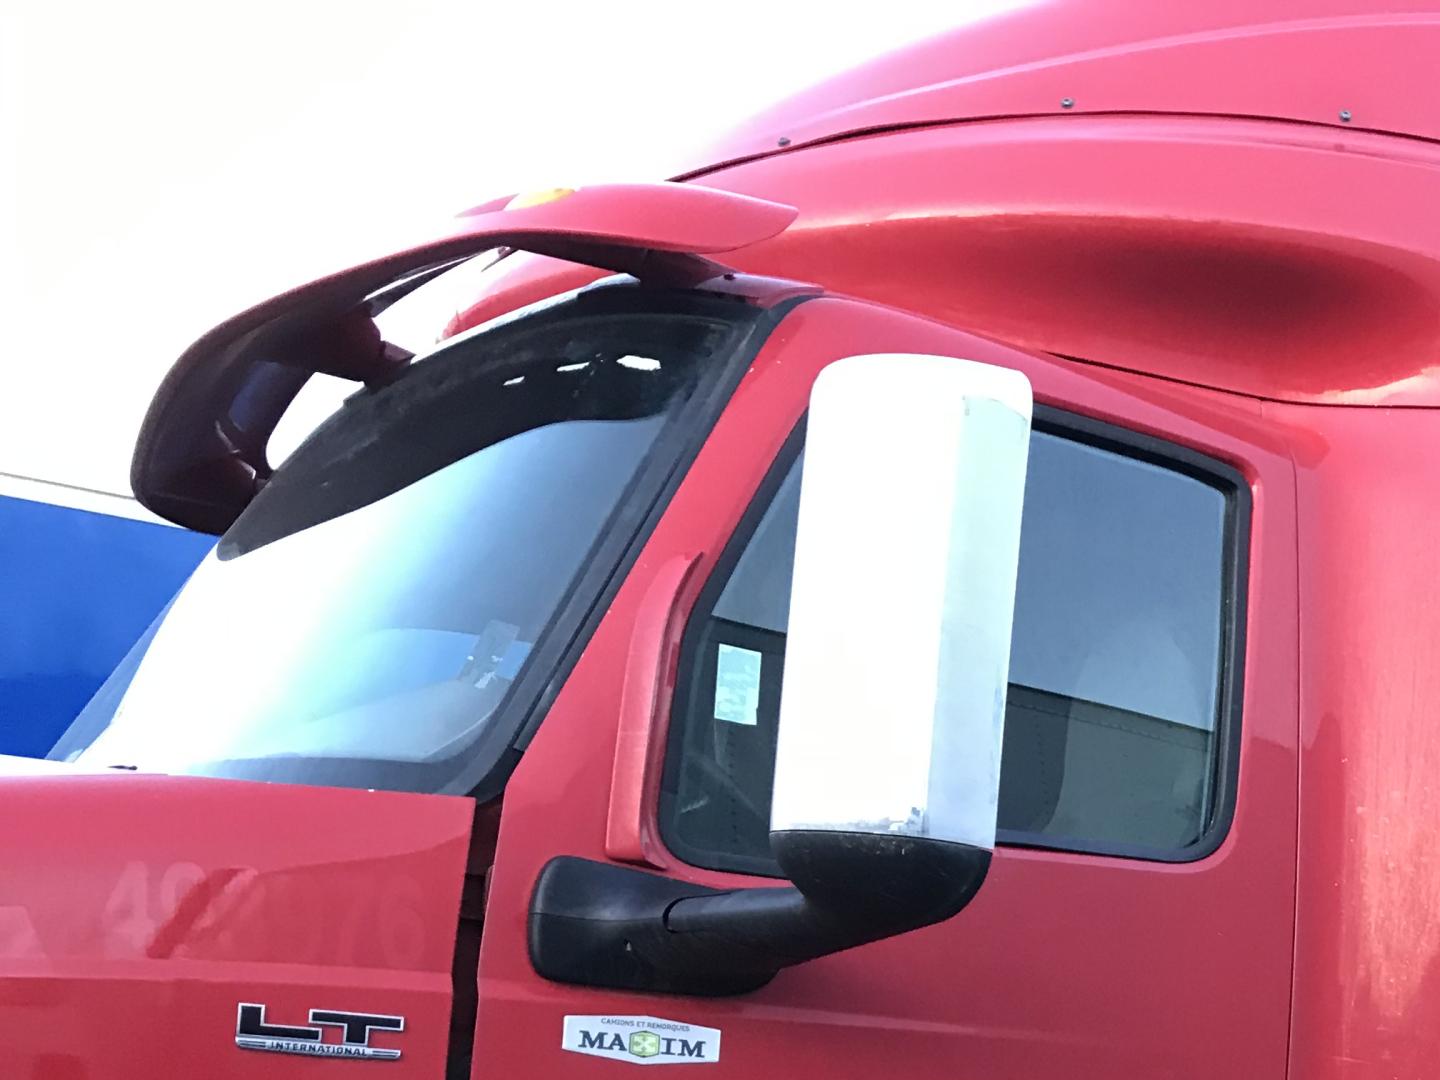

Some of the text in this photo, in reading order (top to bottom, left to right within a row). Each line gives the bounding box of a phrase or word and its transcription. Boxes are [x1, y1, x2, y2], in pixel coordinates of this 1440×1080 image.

[236, 1002, 405, 1046] LT
[601, 1018, 690, 1032] CAMIONS ET REMORQUES
[271, 1042, 368, 1057] INTERNATIONAL
[578, 1030, 706, 1058] MAXIM
